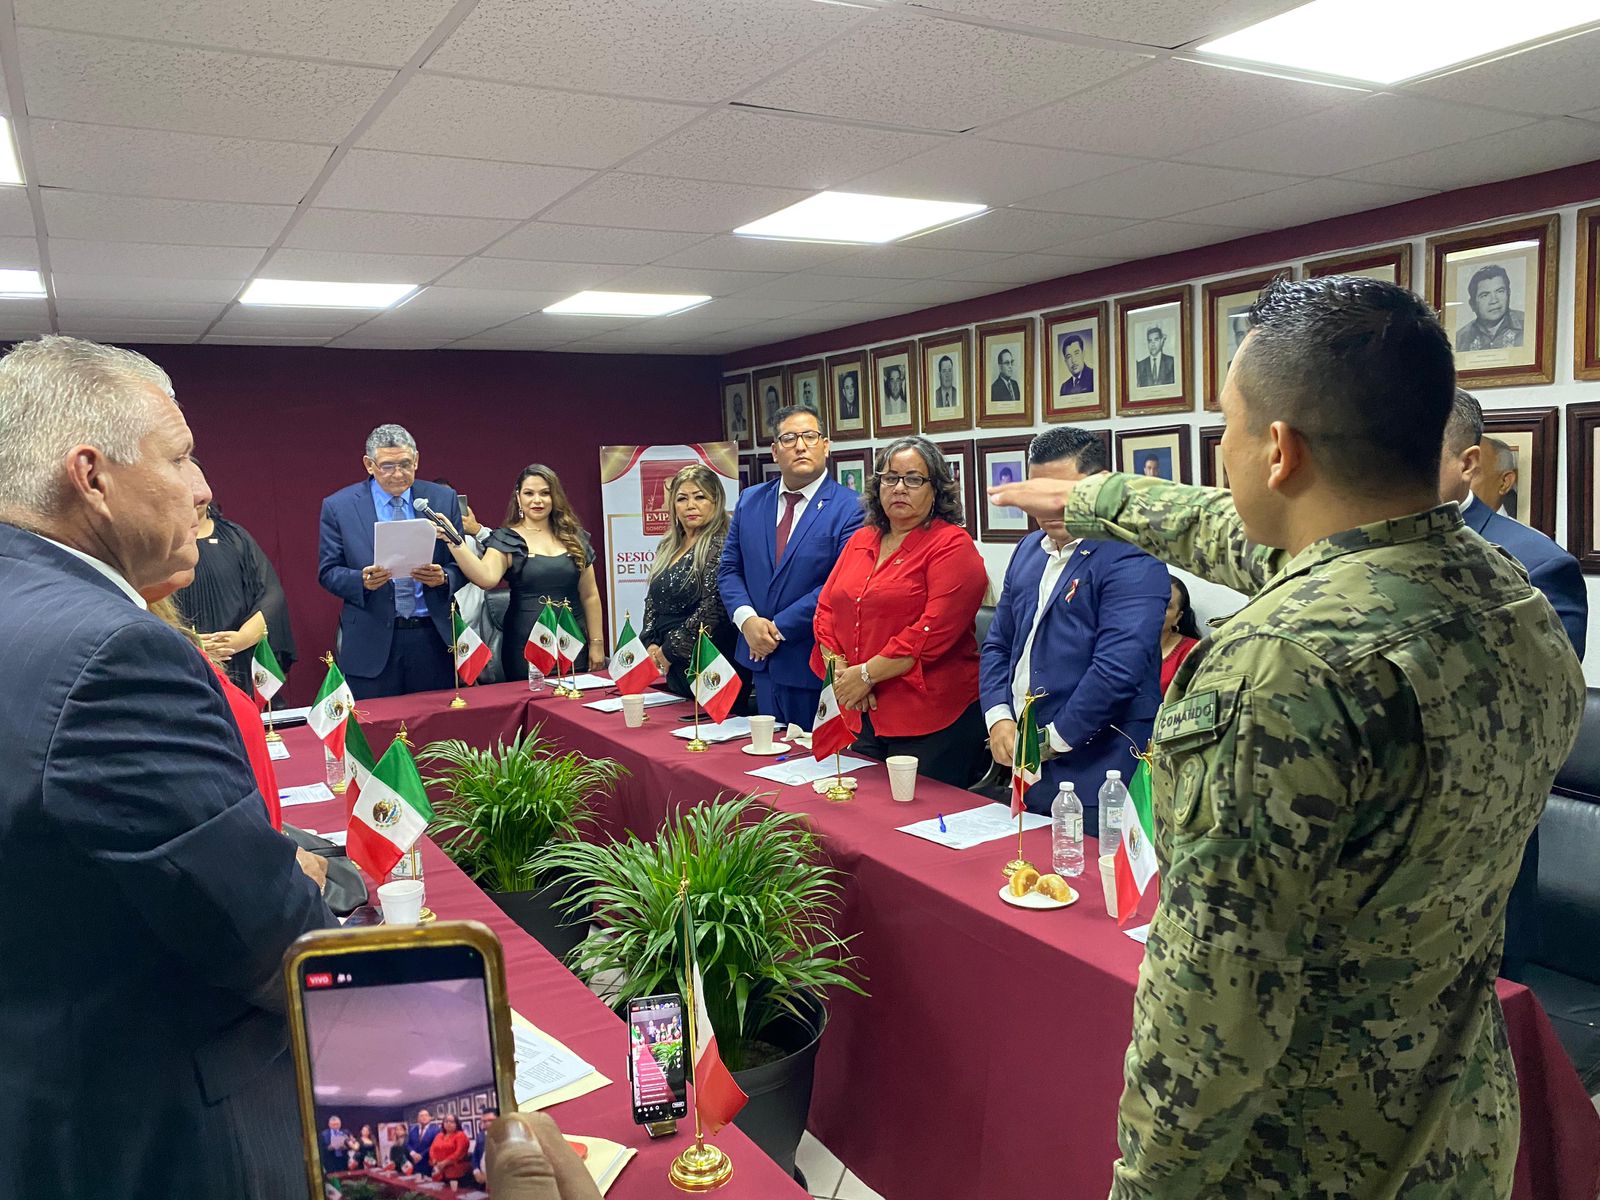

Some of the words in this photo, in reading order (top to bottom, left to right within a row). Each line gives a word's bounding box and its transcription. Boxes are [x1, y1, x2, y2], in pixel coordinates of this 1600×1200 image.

[646, 513, 669, 522] EMP
[617, 549, 656, 562] SESIÓ
[617, 564, 635, 574] DE
[640, 564, 652, 574] IN
[1160, 705, 1211, 729] COMANDO
[309, 975, 329, 984] VIVO
